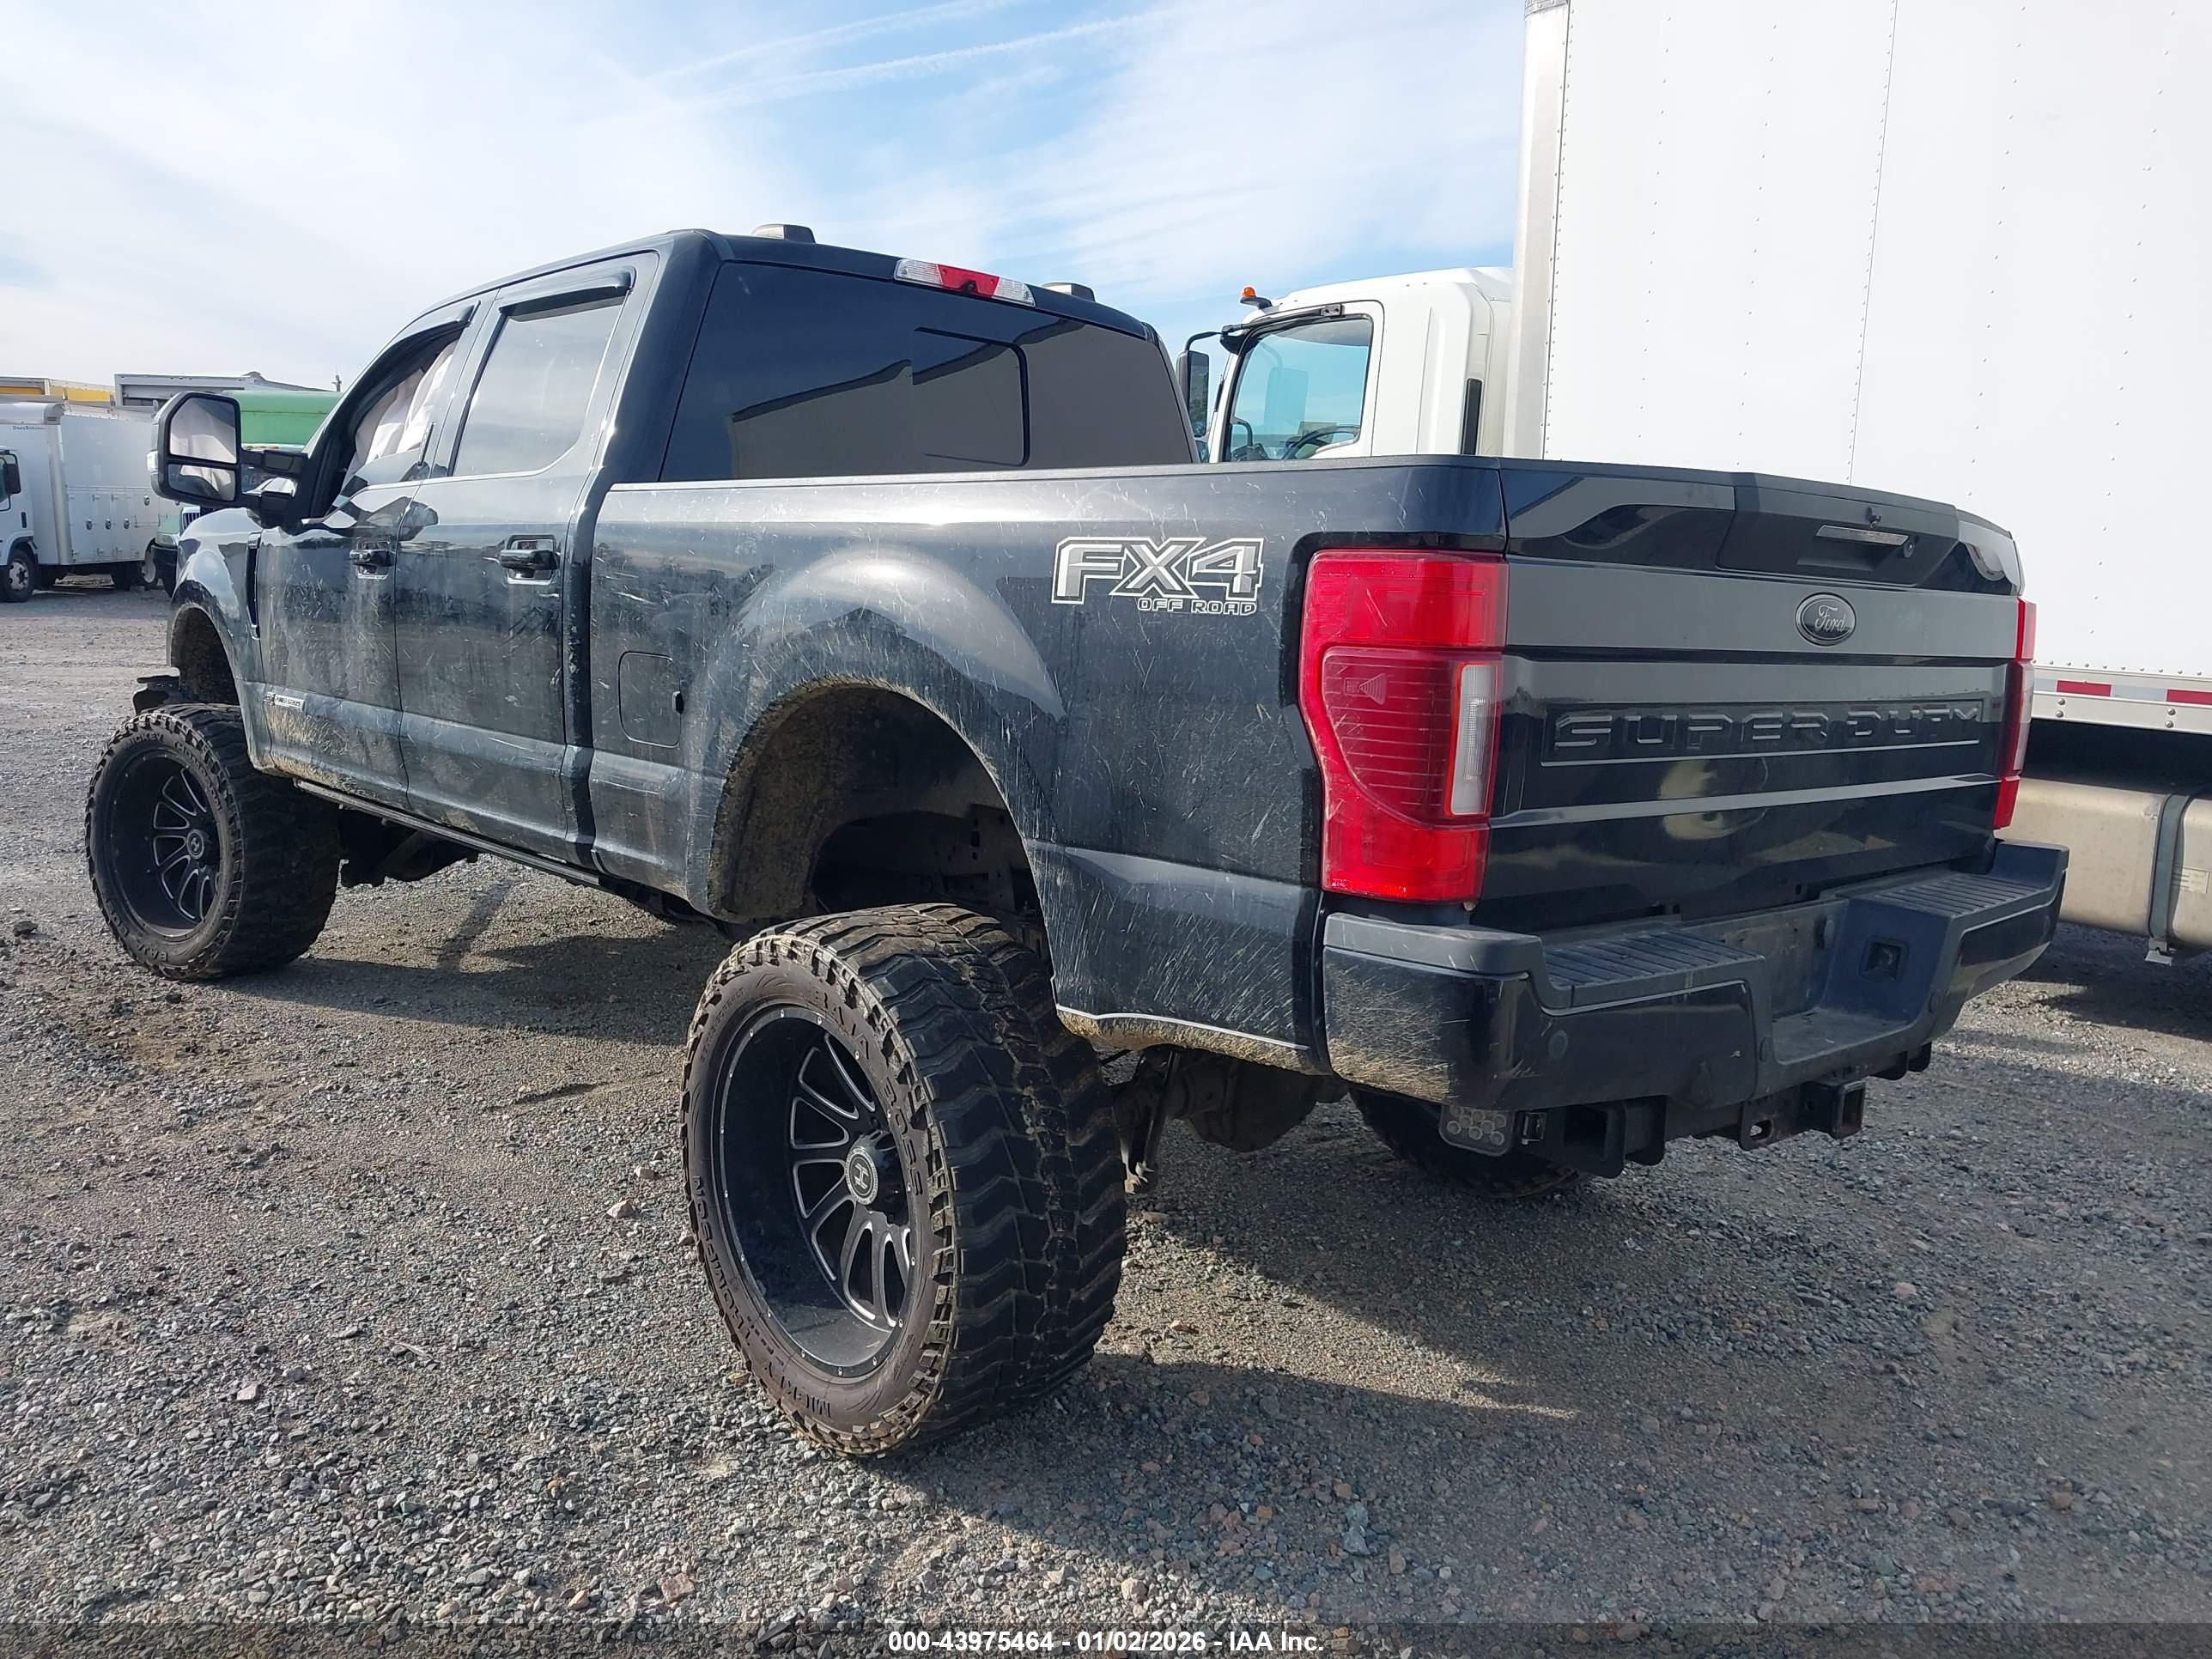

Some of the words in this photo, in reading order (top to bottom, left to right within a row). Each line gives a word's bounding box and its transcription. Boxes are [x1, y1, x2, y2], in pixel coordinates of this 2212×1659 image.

[1051, 536, 1265, 605] FX4
[1137, 597, 1183, 612] OFF
[1191, 599, 1257, 616] ROAD
[1814, 605, 1846, 633] Ford
[1554, 710, 1829, 750] SUPER
[1846, 702, 1982, 738] DUTY
[813, 989, 870, 1060] BAJA
[883, 1076, 924, 1197] BOSS
